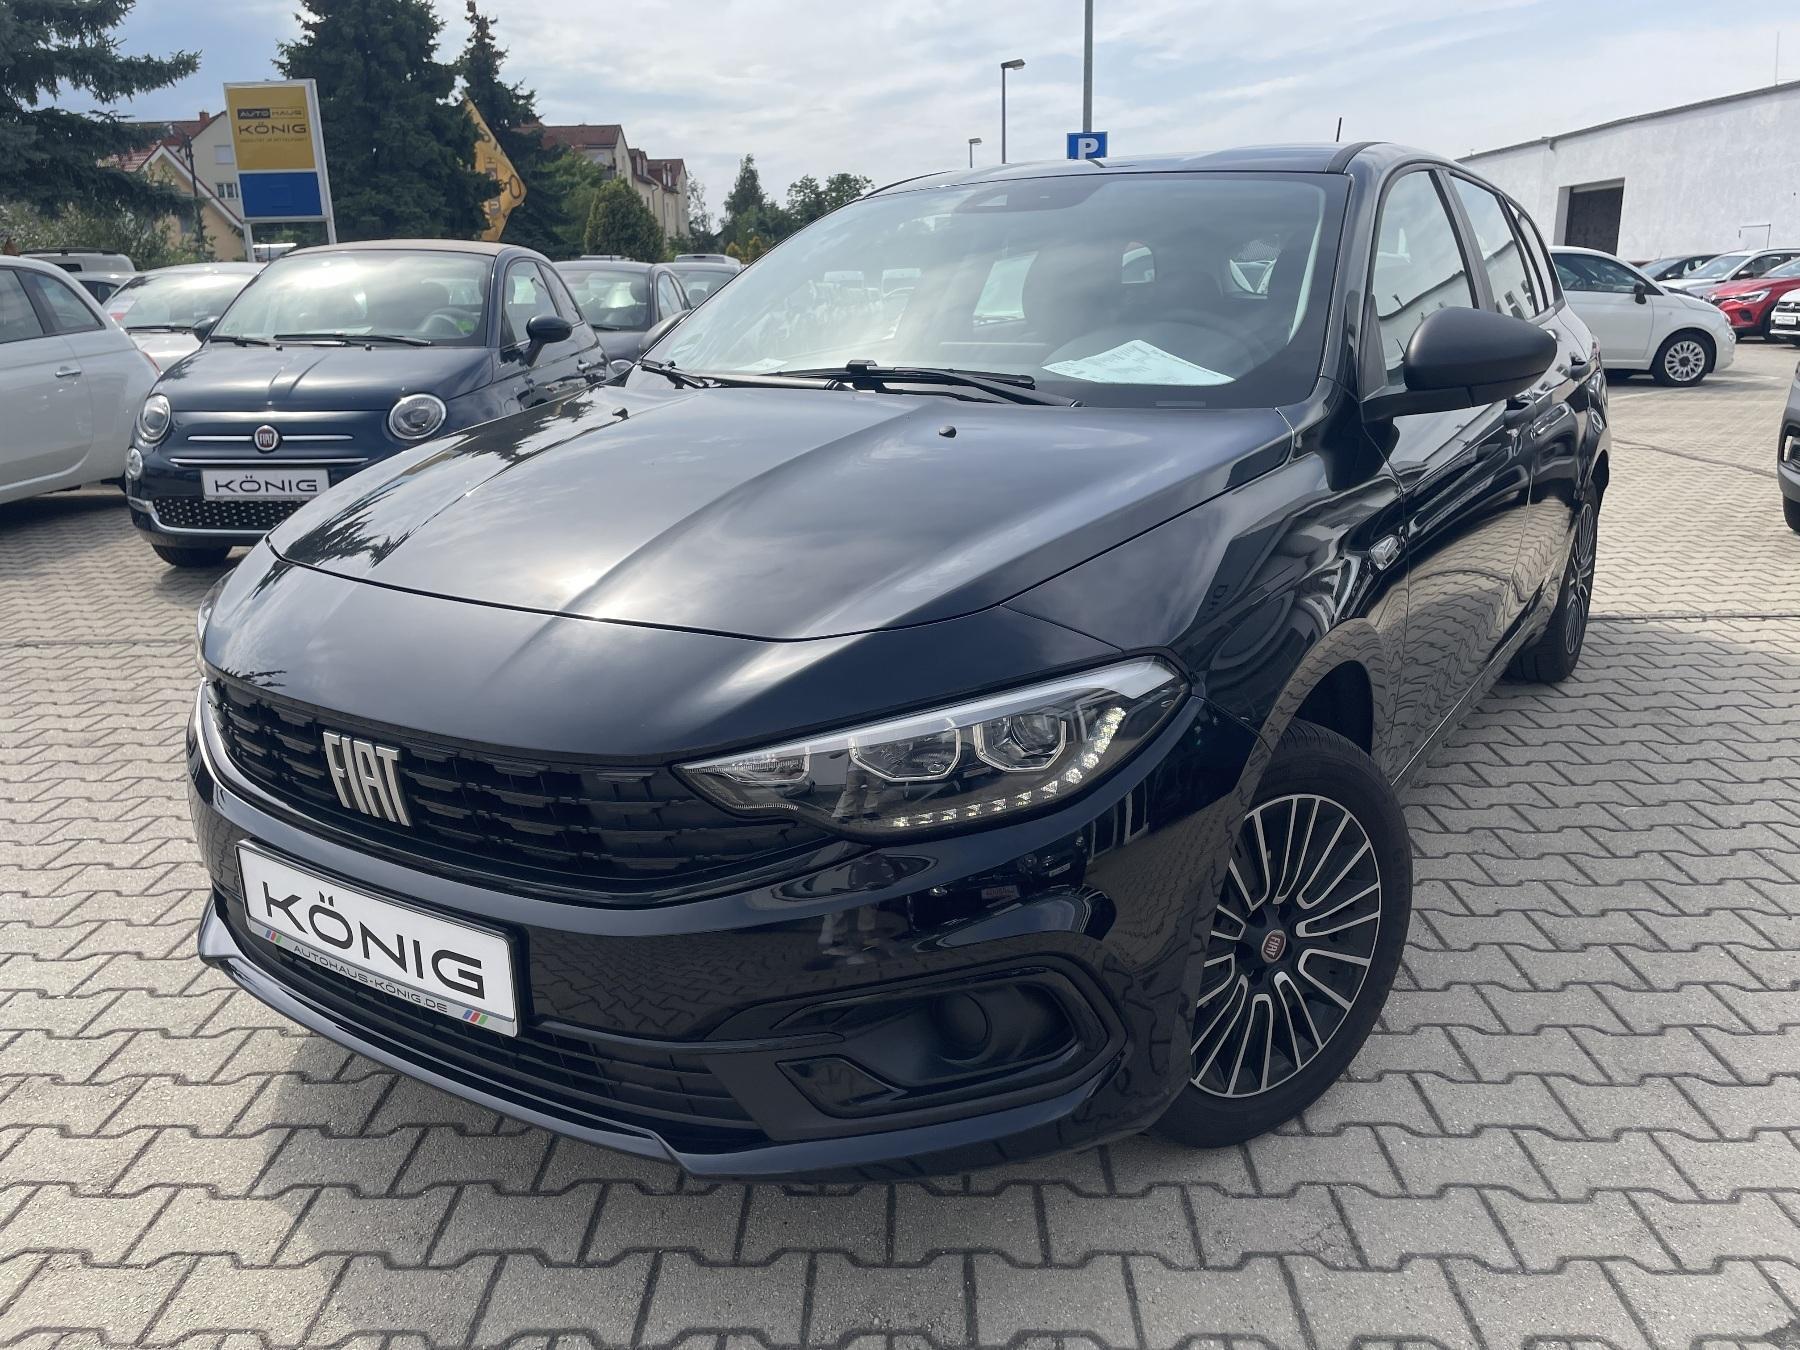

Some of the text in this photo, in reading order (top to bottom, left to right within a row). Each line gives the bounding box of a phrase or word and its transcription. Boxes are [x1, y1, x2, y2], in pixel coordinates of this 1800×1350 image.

[239, 121, 307, 135] KÖNIG
[1078, 137, 1099, 160] P
[259, 433, 273, 446] FIAT
[214, 474, 318, 493] KÖNIG
[323, 730, 411, 827] FIAT
[262, 881, 486, 1000] KÖNIG
[1265, 935, 1281, 957] FIAT
[293, 944, 448, 1013] AUTOHAUS-KÖNIG.DE
